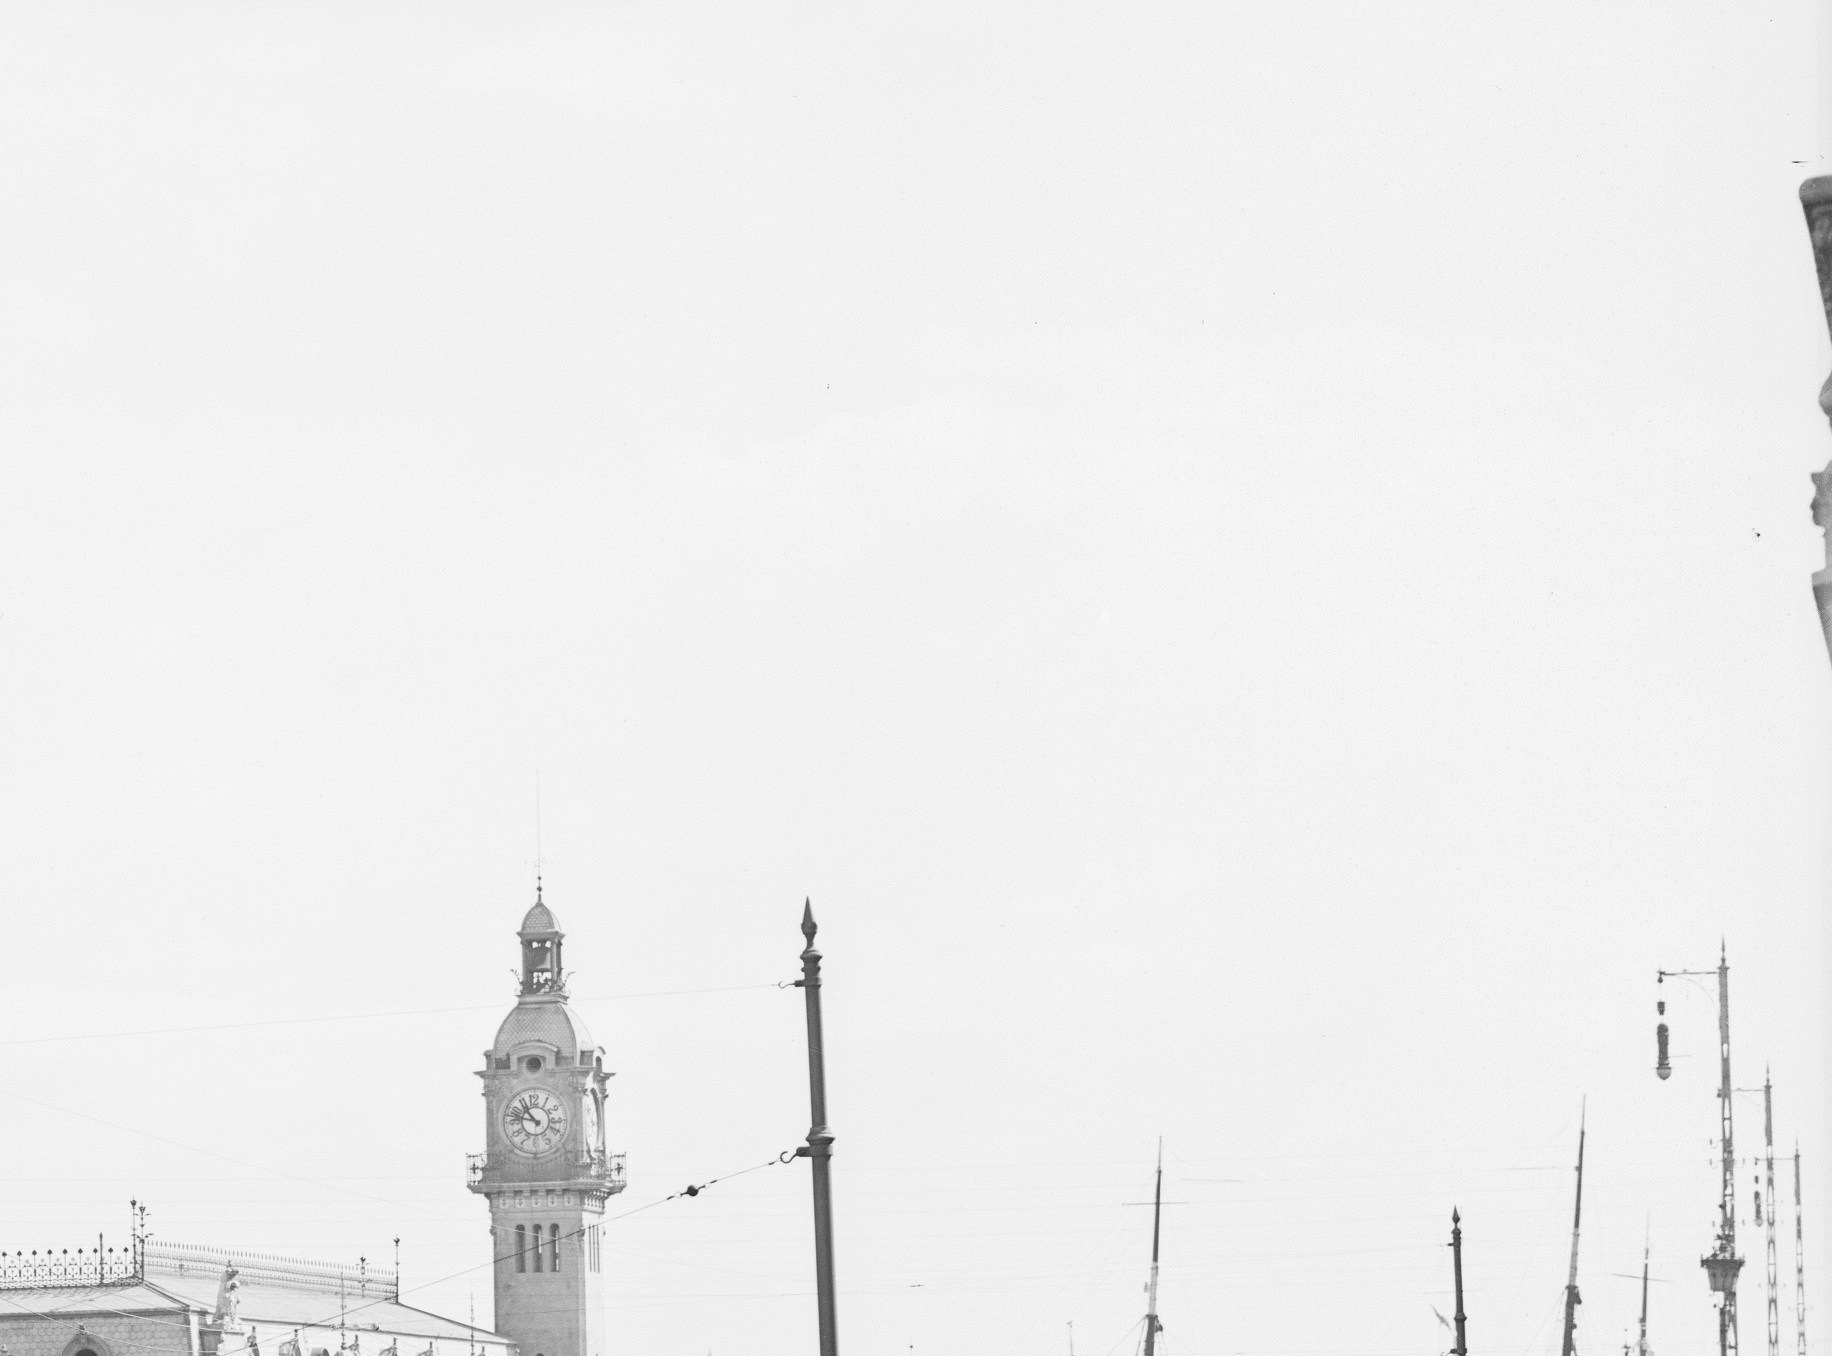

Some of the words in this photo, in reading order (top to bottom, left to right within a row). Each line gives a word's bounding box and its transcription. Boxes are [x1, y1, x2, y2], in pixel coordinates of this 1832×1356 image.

[529, 1093, 539, 1107] 12
[543, 1096, 549, 1108] 1
[547, 1104, 559, 1115] 2
[512, 1128, 523, 1138] 8
[520, 1133, 531, 1146] 7
[542, 1133, 552, 1146] 5
